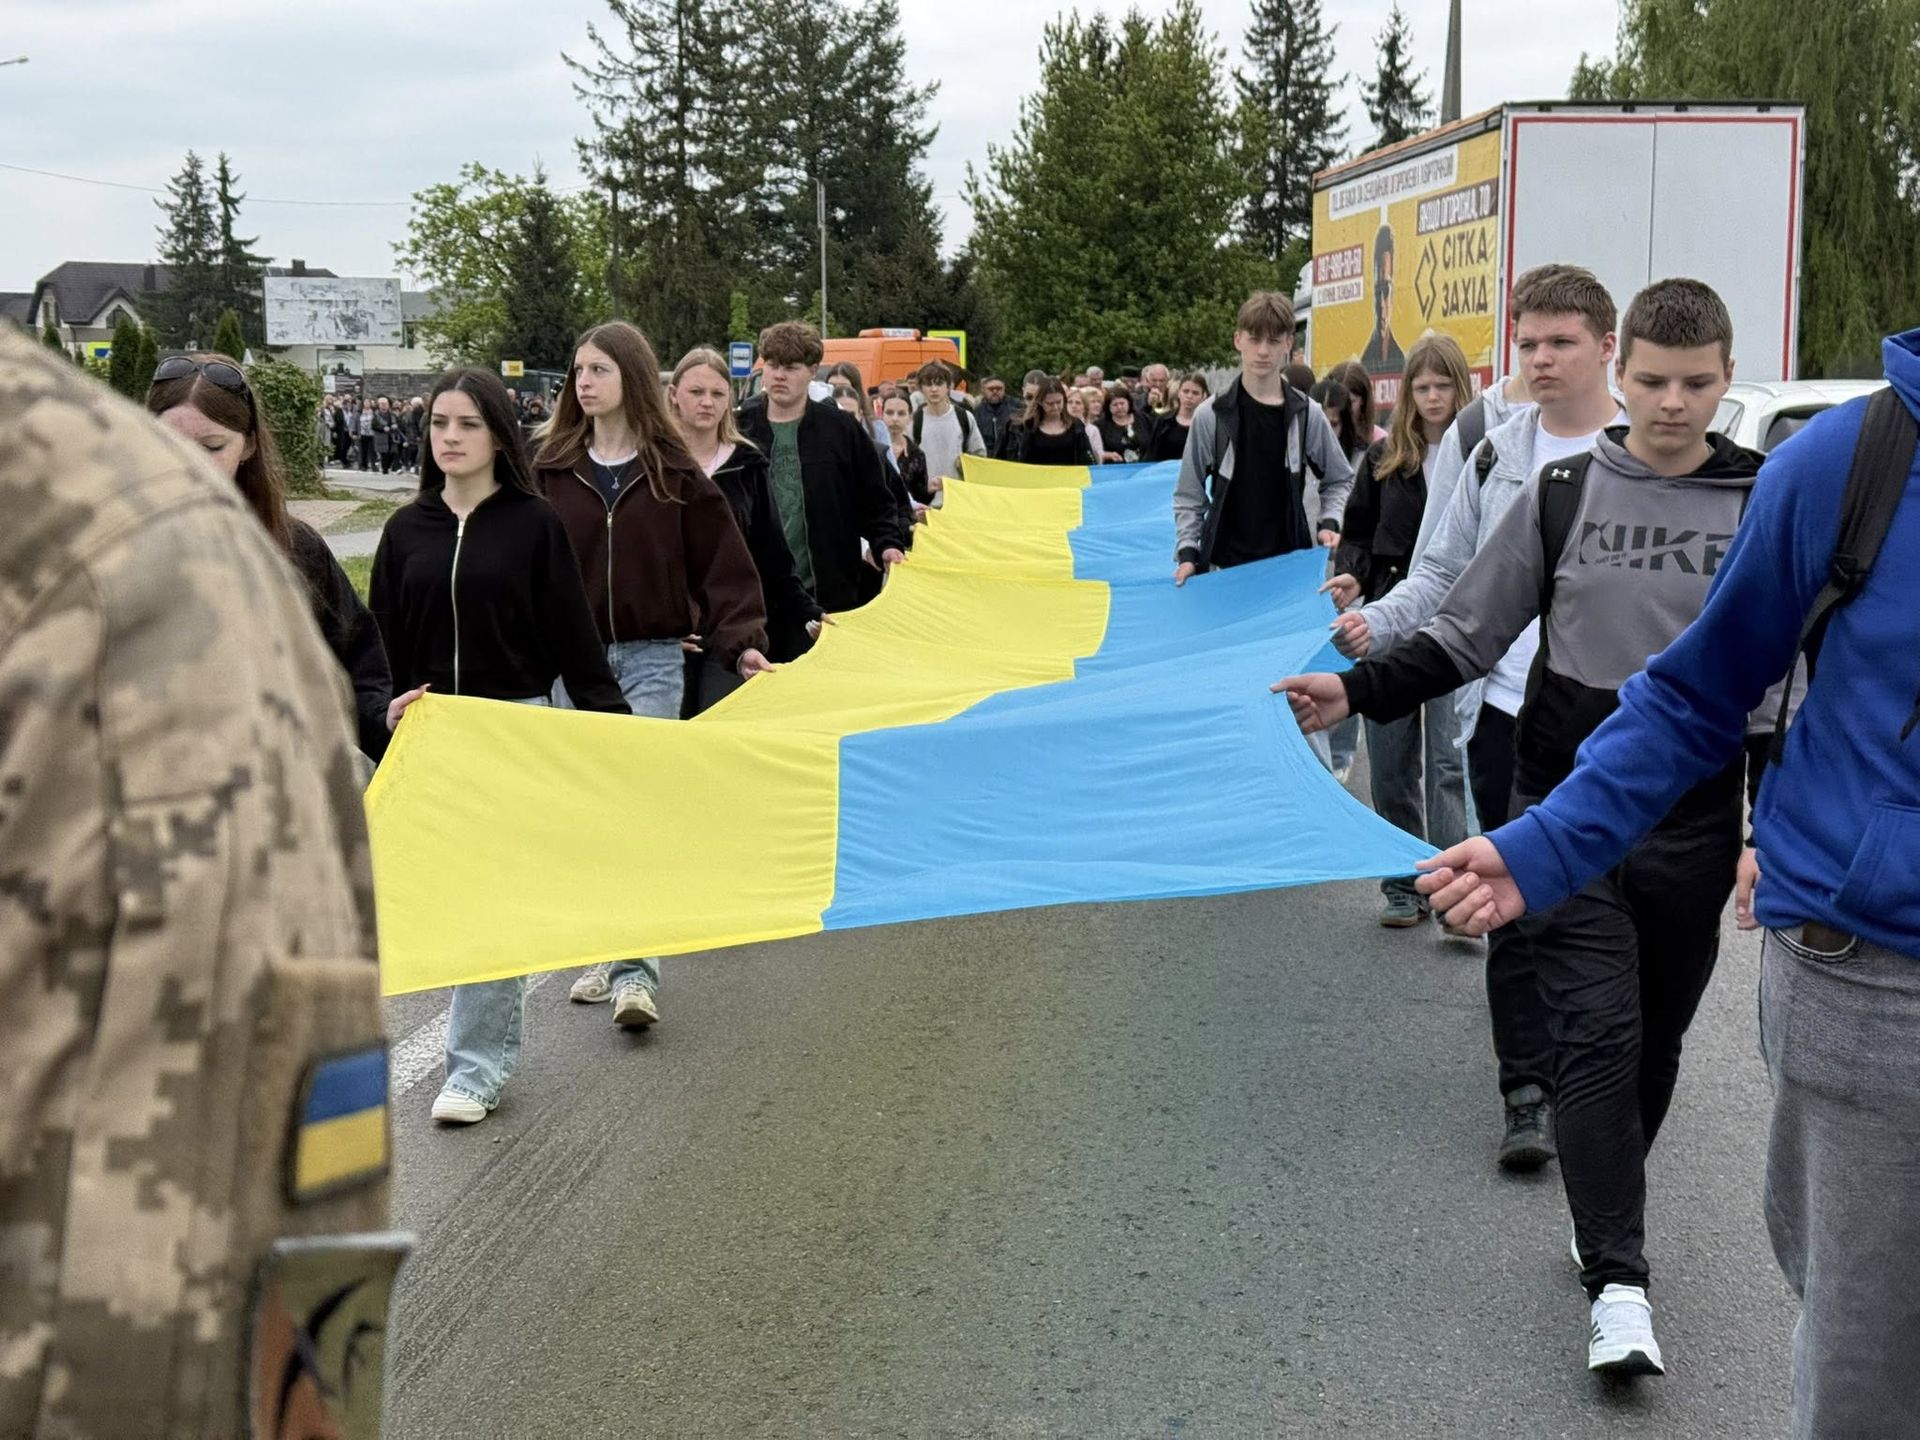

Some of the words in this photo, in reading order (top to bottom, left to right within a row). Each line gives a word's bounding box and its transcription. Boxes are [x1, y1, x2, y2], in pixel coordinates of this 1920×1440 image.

[1442, 226, 1488, 270] СІТКА
[1442, 275, 1488, 318] ЗАХІД
[1579, 521, 1734, 576] NIKE
